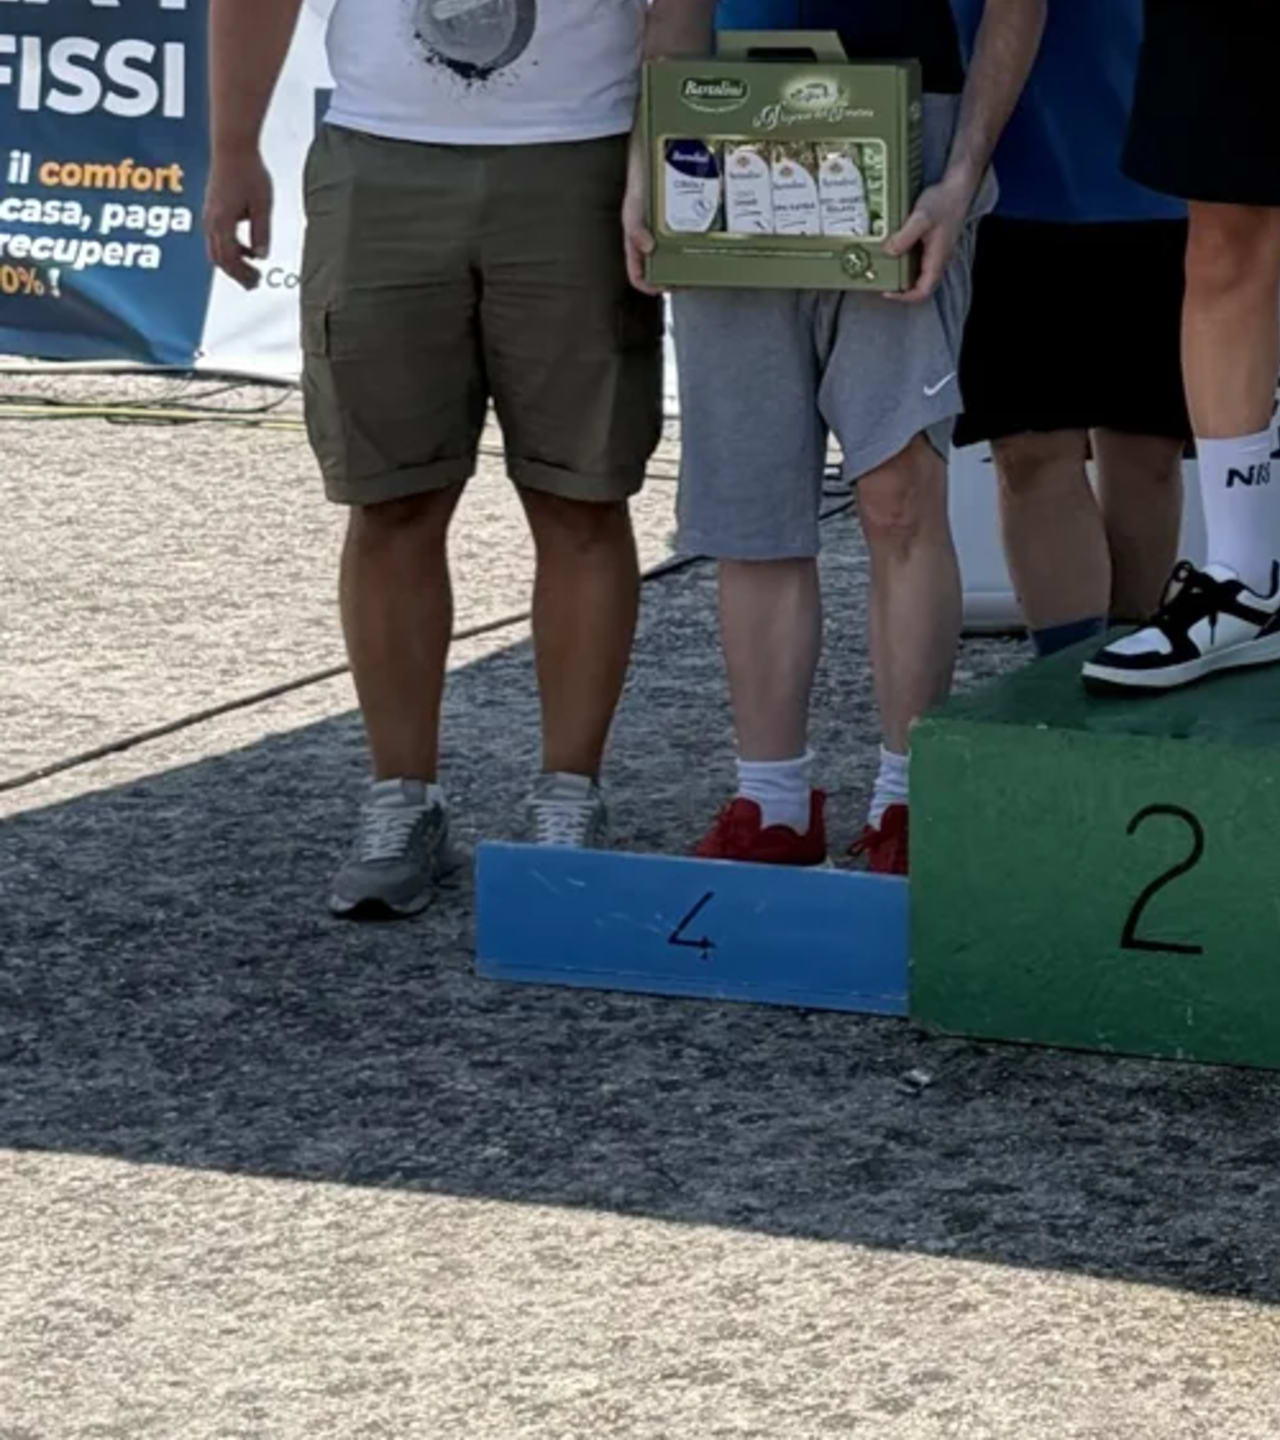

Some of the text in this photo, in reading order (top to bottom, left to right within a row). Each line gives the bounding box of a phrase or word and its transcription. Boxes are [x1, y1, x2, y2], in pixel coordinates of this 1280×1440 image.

[8, 150, 184, 193] il comfort
[0, 197, 193, 238] casa, paga
[0, 231, 162, 271] recupera
[1120, 803, 1203, 954] 2
[668, 891, 715, 960] 4
